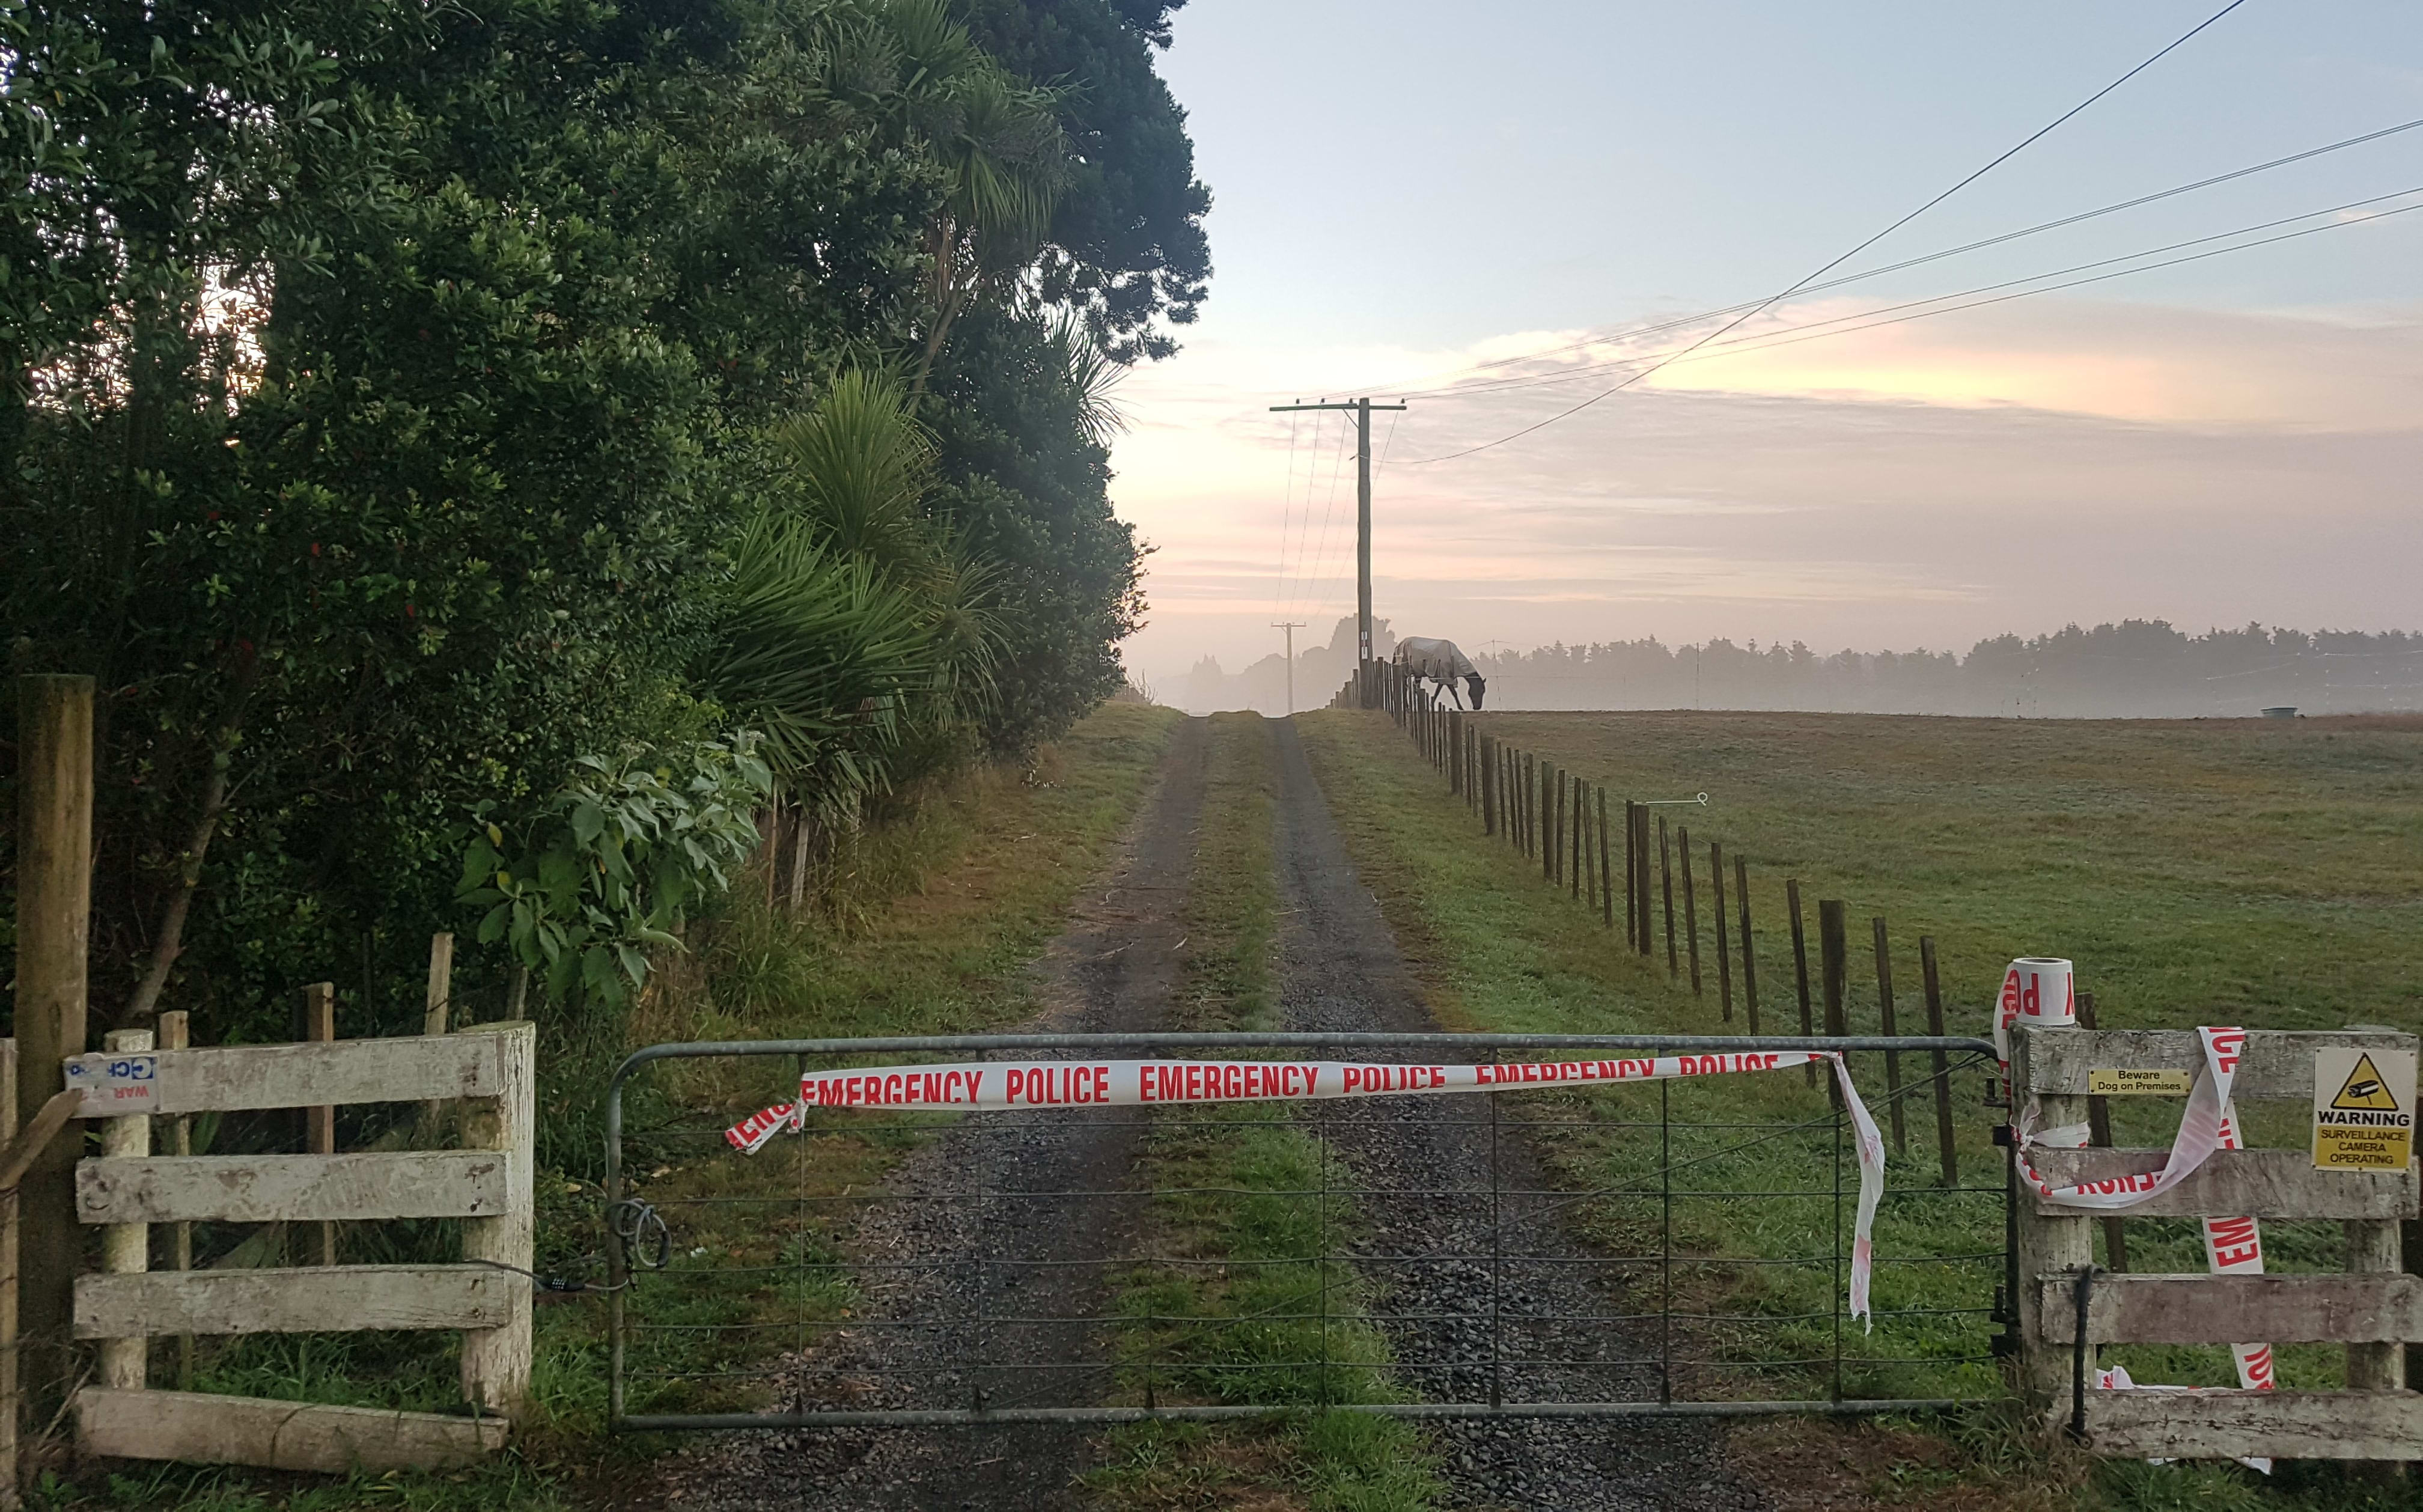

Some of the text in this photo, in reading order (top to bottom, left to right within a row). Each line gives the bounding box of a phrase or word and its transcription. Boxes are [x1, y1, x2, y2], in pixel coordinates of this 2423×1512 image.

[2118, 1070, 2160, 1079] Beware
[800, 1070, 983, 1106] EMERGENCY
[1006, 1067, 1109, 1104] POLICE
[1140, 1065, 1319, 1102] EMERGENCY
[1343, 1067, 1446, 1094] POLICE
[1475, 1058, 1654, 1085] EMERGENCY
[2098, 1082, 2118, 1091] Dog
[2136, 1082, 2181, 1090] Premises
[2318, 1111, 2410, 1126] WARNING
[2321, 1129, 2406, 1141] SURVEILLANCE
[2338, 1142, 2386, 1151] CAMERA
[2330, 1153, 2394, 1164] OPERATING
